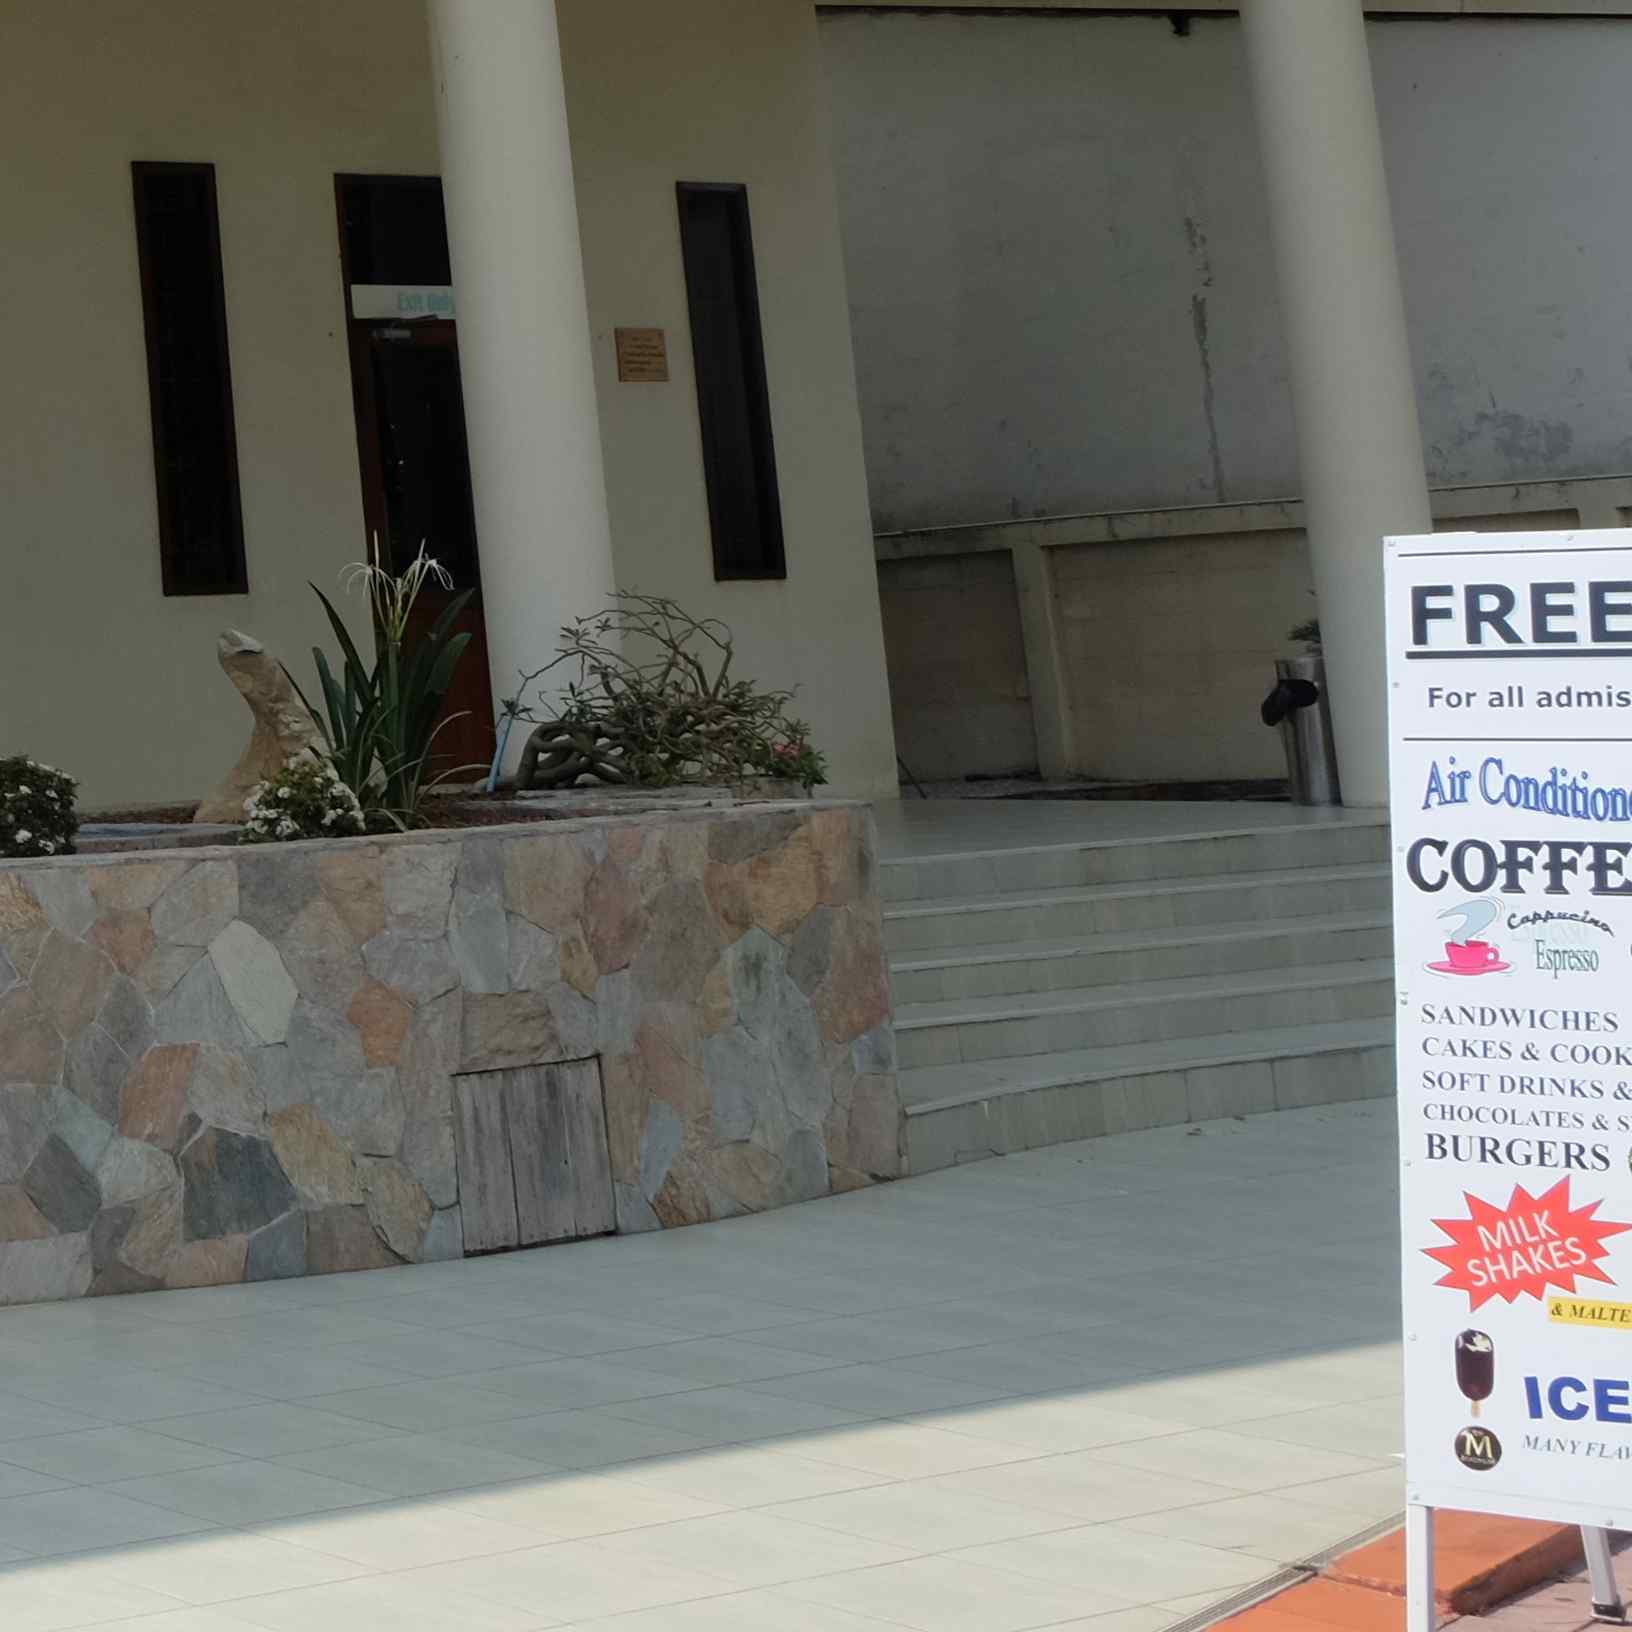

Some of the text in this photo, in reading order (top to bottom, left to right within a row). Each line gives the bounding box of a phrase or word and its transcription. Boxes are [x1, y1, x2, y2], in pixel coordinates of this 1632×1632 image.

[1409, 580, 1632, 646] FREE
[1428, 685, 1632, 709] For all admis
[1422, 756, 1632, 823] Air Condition
[1406, 837, 1632, 897] COFFE
[1535, 939, 1599, 979] Espresso
[1421, 1003, 1619, 1033] SANDWICHES
[1422, 1036, 1632, 1066] CAKES & COOK
[1422, 1070, 1632, 1101] SOFT DRINKS &
[1423, 1103, 1585, 1129] CHOCOLATES
[1592, 1114, 1609, 1131] &
[1424, 1133, 1611, 1172] BURGERS
[1477, 1210, 1559, 1252] MILK
[1467, 1237, 1586, 1286] SHAKES
[1551, 1303, 1564, 1317] &
[1524, 1376, 1632, 1424] ICE
[1522, 1435, 1581, 1455] MANY
